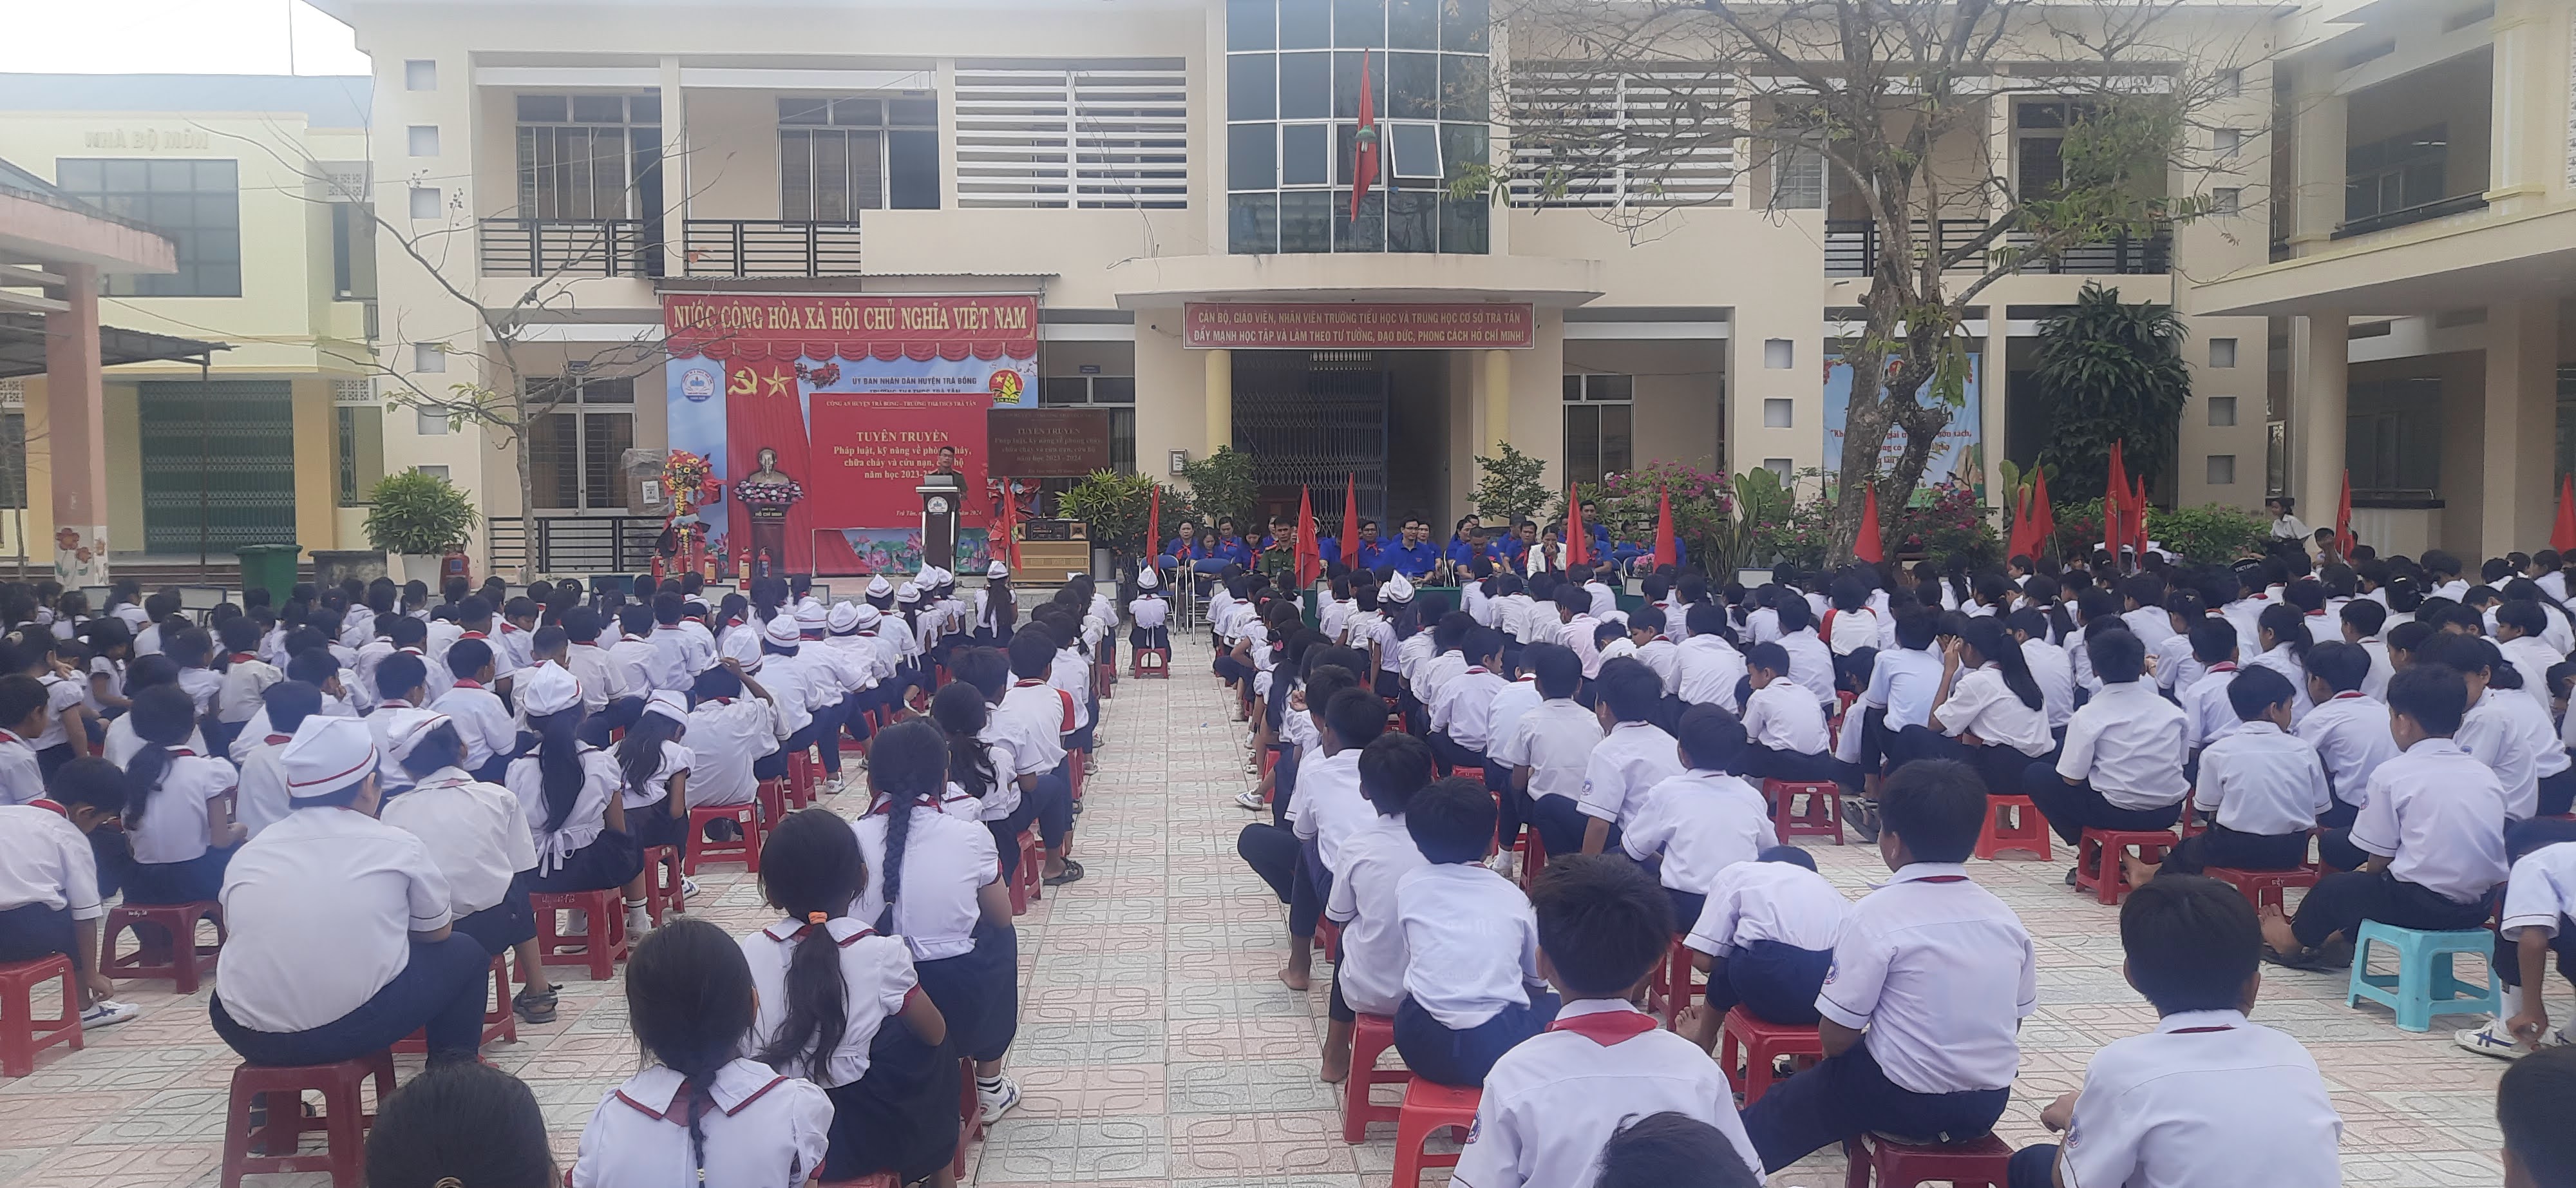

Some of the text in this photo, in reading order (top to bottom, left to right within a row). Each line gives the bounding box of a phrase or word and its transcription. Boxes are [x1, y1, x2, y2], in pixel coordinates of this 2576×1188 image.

[674, 298, 1027, 336] NƯỚC CÔNG HÒA XÃ HỘI CHỦ NGHĨA VIỆT NAM
[1412, 312, 1438, 323] TRUNG
[1309, 330, 1331, 341] THEO
[1418, 330, 1445, 341] PHONG
[1501, 330, 1524, 341] MINH!
[856, 428, 897, 442] TUYÊN
[834, 446, 855, 456] Pháp
[923, 445, 940, 456] phò
[954, 445, 972, 456] háy,
[866, 458, 885, 468] cháy
[865, 470, 882, 479] năm
[884, 470, 898, 480] học
